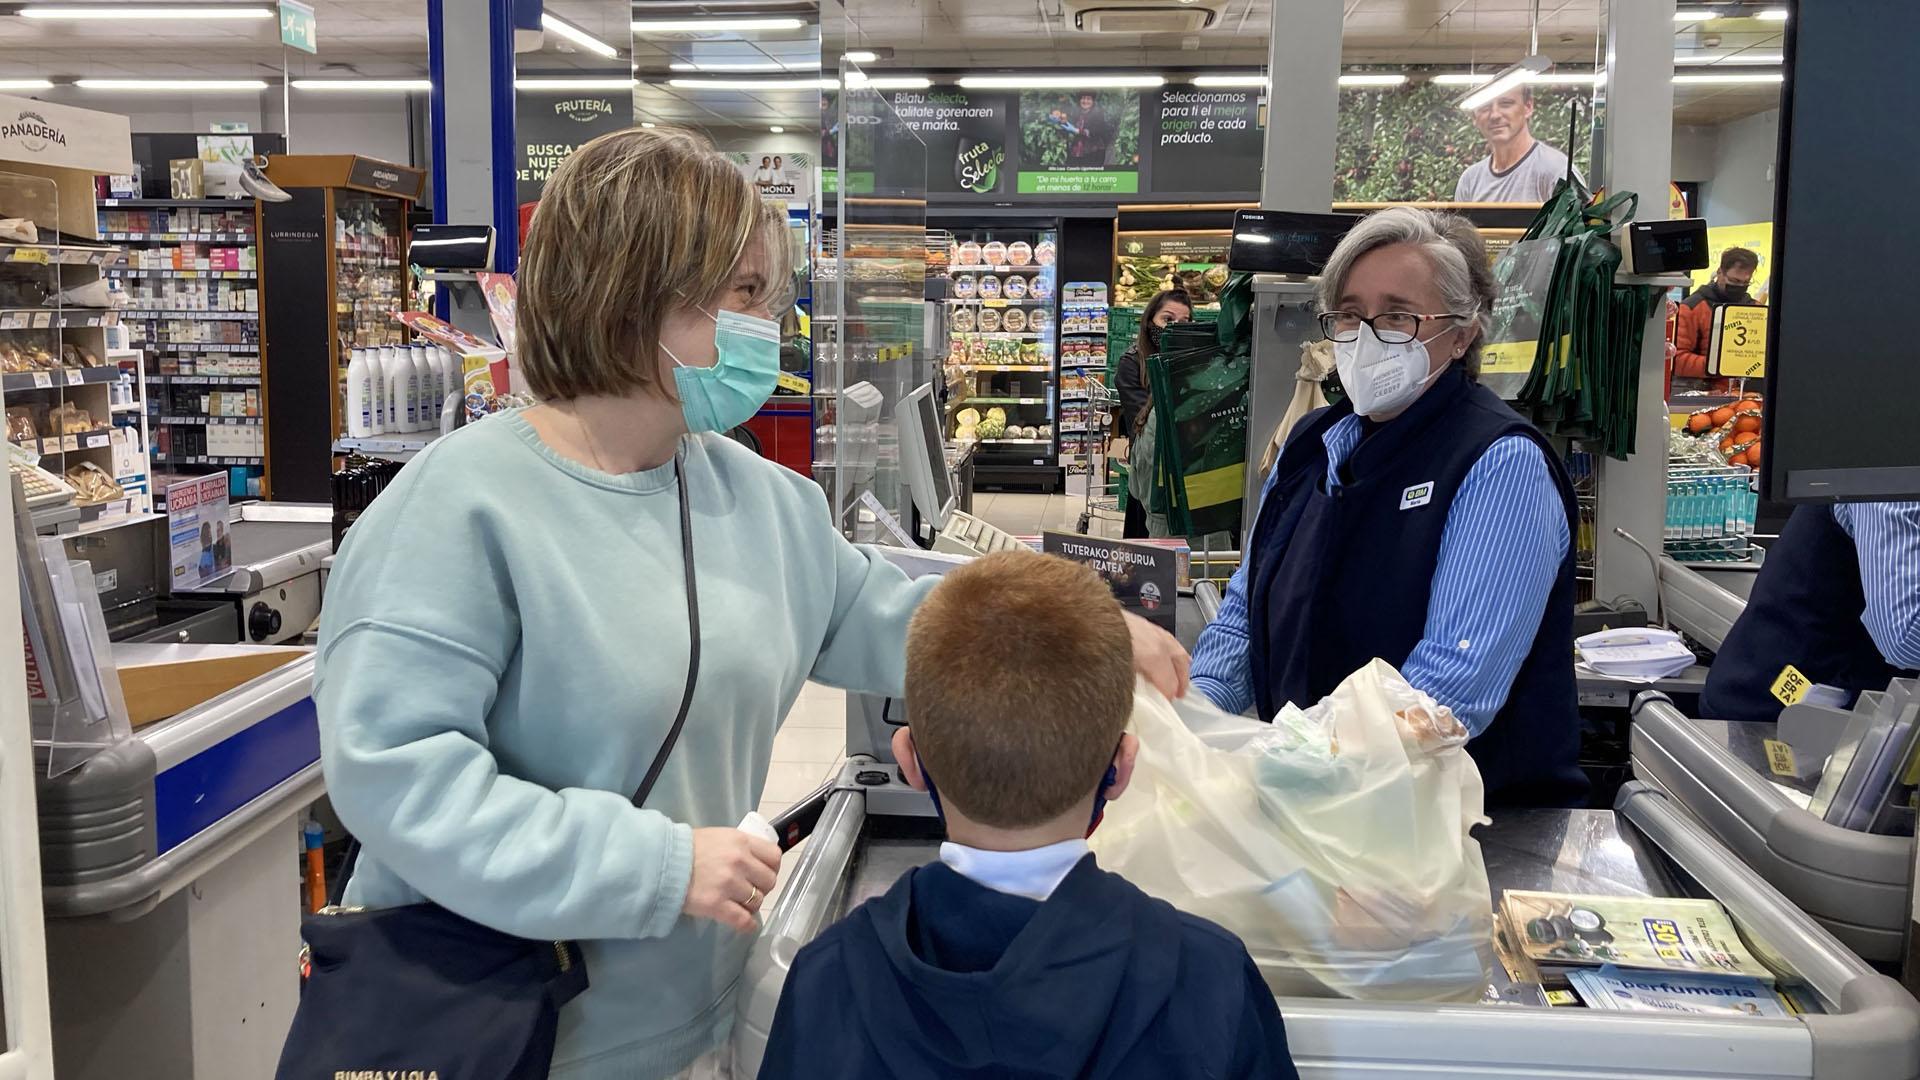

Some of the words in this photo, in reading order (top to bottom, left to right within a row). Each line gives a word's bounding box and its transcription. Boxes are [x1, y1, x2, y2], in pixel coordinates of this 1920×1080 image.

[894, 92, 925, 104] Bilatu
[1162, 90, 1247, 104] Seleccionamos
[554, 98, 613, 115] FRUTERÍA
[895, 105, 934, 118] kalitate
[936, 107, 993, 120] gorenaren
[1161, 106, 1188, 120] para
[1191, 105, 1199, 117] ti
[1200, 104, 1212, 117] el
[1214, 104, 1247, 118] mejor
[922, 119, 960, 131] marka.
[1161, 118, 1198, 133] origen
[1199, 117, 1215, 130] de
[1217, 117, 1247, 130] cada
[1, 123, 67, 147] PANADERÍA
[1160, 131, 1214, 147] producto.
[526, 144, 573, 156] BUSCA
[958, 141, 990, 165] fruta
[761, 185, 793, 194] MONIX
[269, 231, 320, 239] LURRINDEGIA
[1733, 326, 1748, 347] 3
[1062, 542, 1110, 560] TUTERAKO
[1110, 550, 1157, 568] ORBURUA
[1092, 561, 1124, 574] IZATEA
[1783, 680, 1798, 696] ER
